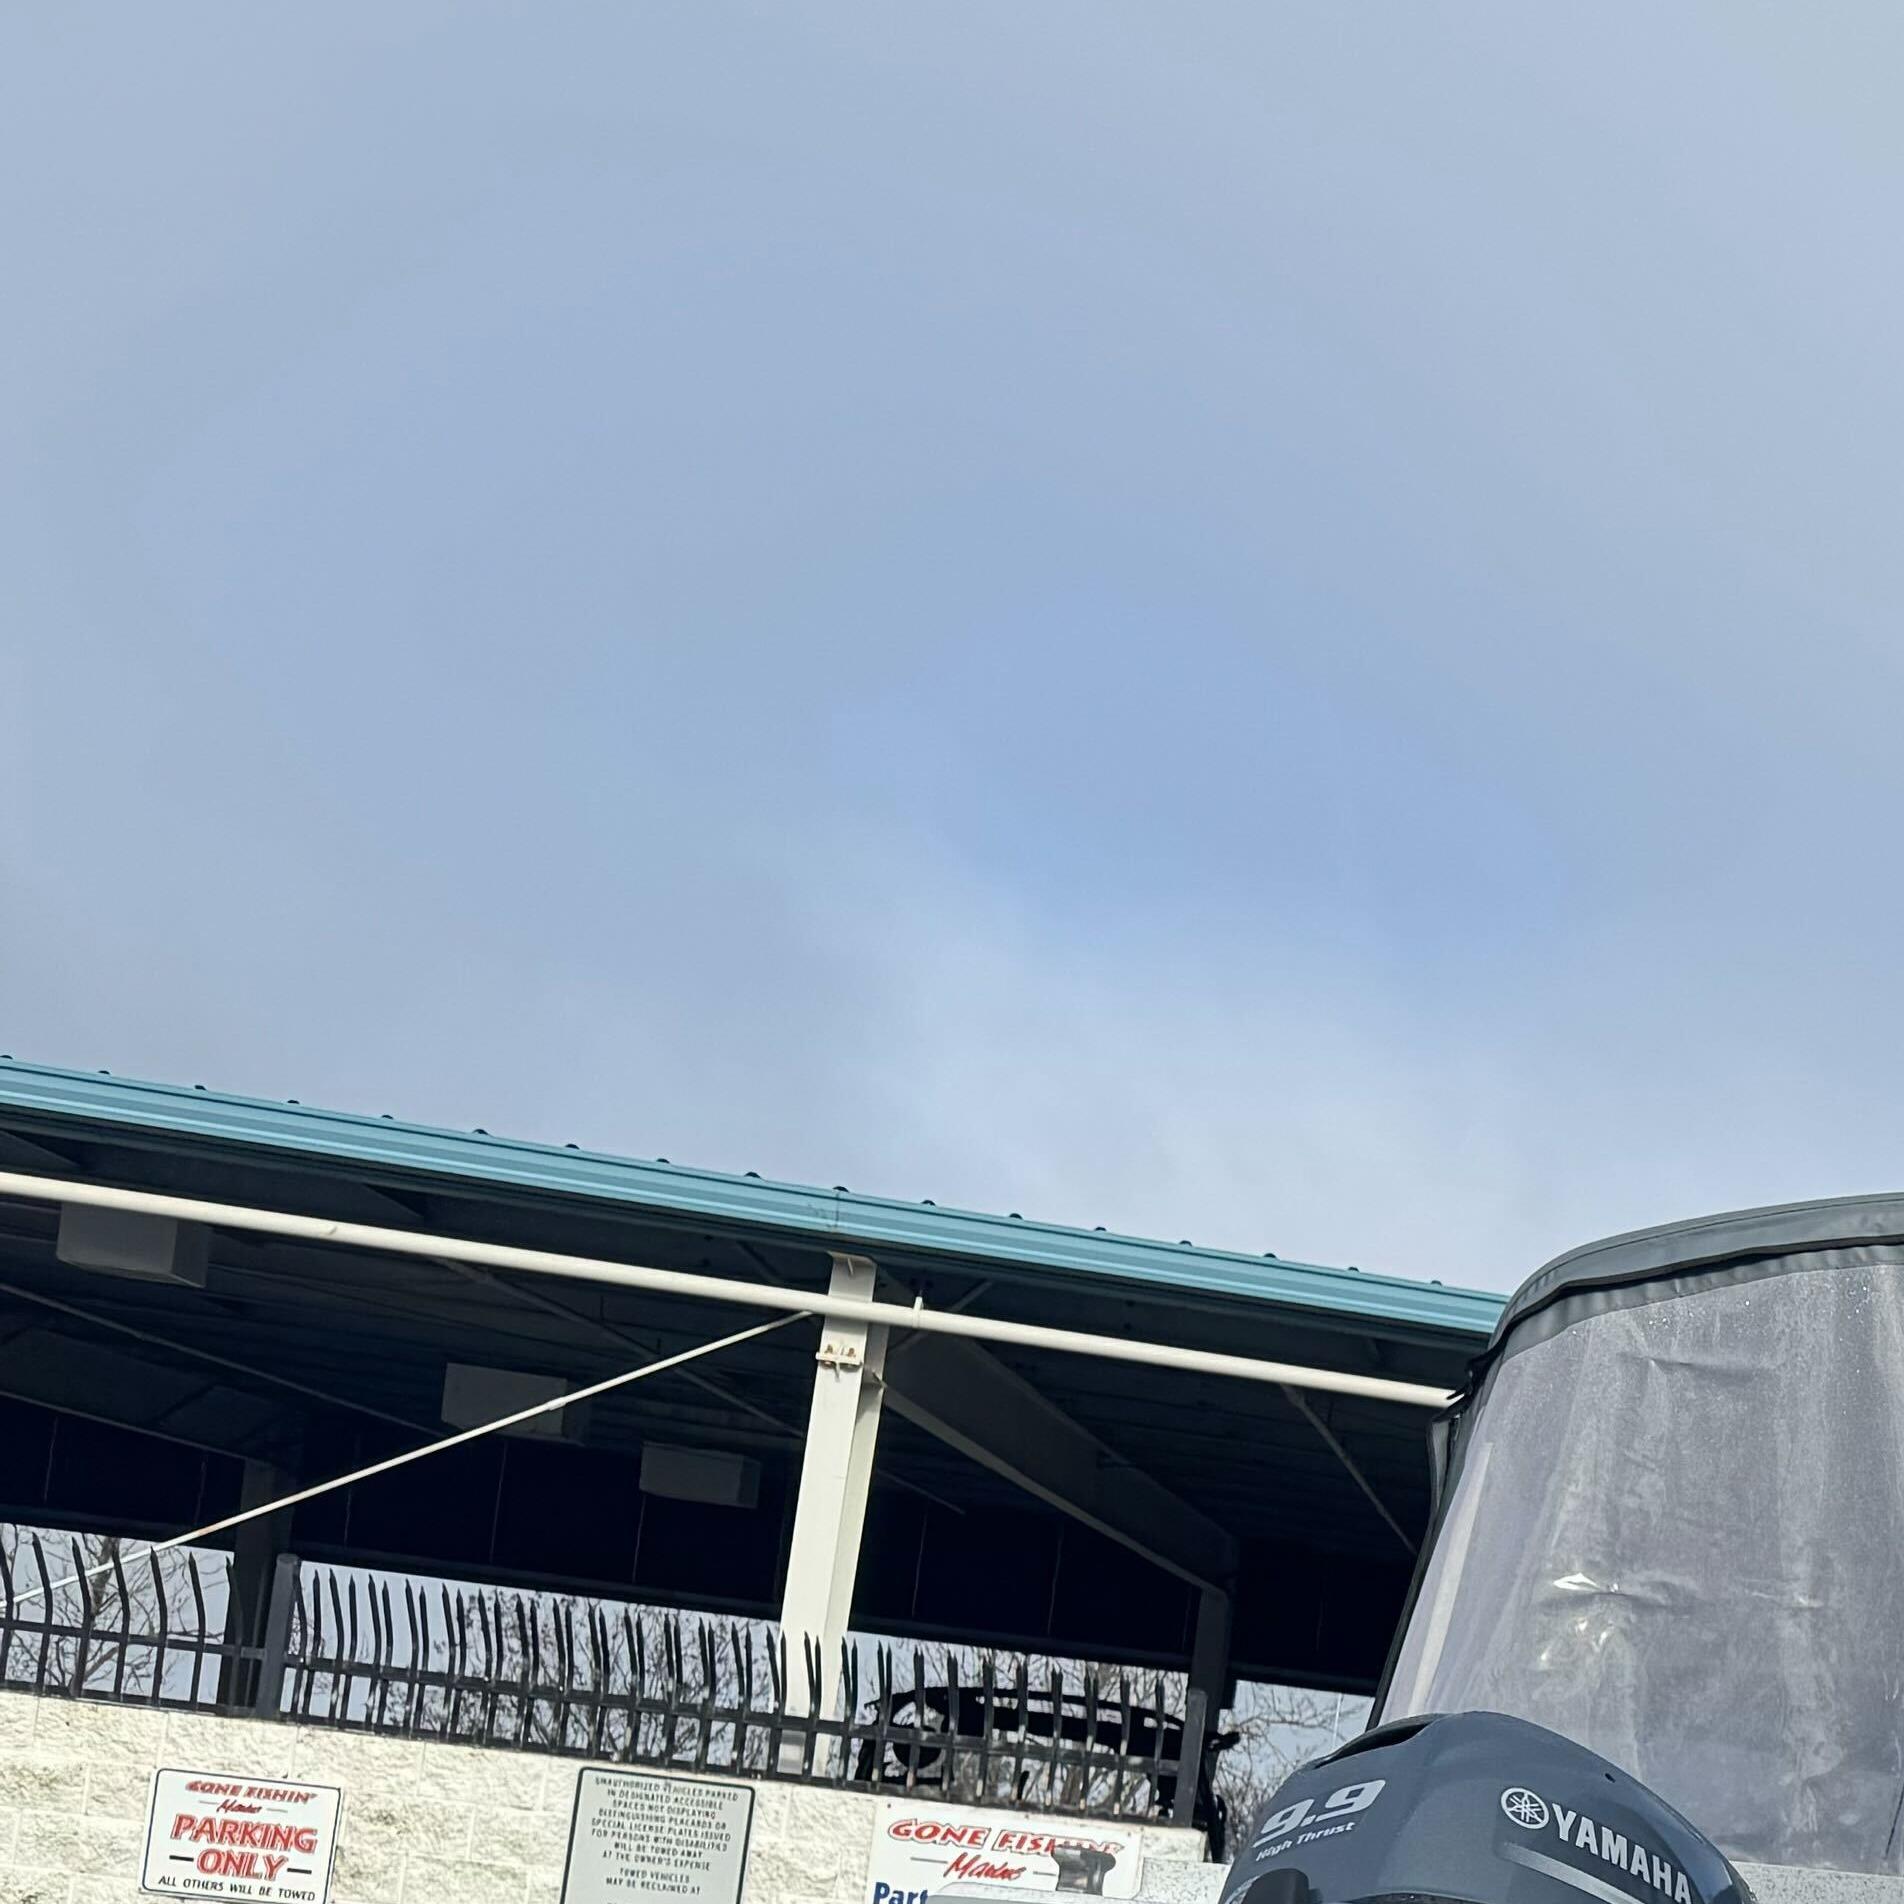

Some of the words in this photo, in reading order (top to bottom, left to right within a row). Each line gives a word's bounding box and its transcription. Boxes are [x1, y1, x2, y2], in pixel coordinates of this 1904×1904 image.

[186, 1781, 243, 1796] GONE
[1252, 1779, 1386, 1848] 9.9
[170, 1813, 318, 1854] PARKING
[591, 1817, 624, 1830] SPECIAL
[667, 1826, 698, 1838] PLATES
[592, 1827, 608, 1838] FOR
[887, 1817, 992, 1850] GONE
[614, 1841, 632, 1853] WILL
[636, 1843, 646, 1854] BE
[650, 1845, 678, 1857] TOWED
[680, 1849, 703, 1859] AWAY
[1256, 1840, 1293, 1861] High
[1296, 1822, 1357, 1845] Thrust
[196, 1848, 288, 1881] ONLY
[603, 1849, 612, 1859] AT
[606, 1876, 623, 1887] MAY
[626, 1878, 636, 1889] BE
[620, 1867, 647, 1879] TOWED
[650, 1871, 690, 1884] VEHICLES
[158, 1875, 177, 1887] ALL
[182, 1878, 224, 1892] OTHERS
[229, 1882, 252, 1895] WILL
[258, 1885, 273, 1896] BE
[278, 1888, 316, 1901] TOWED
